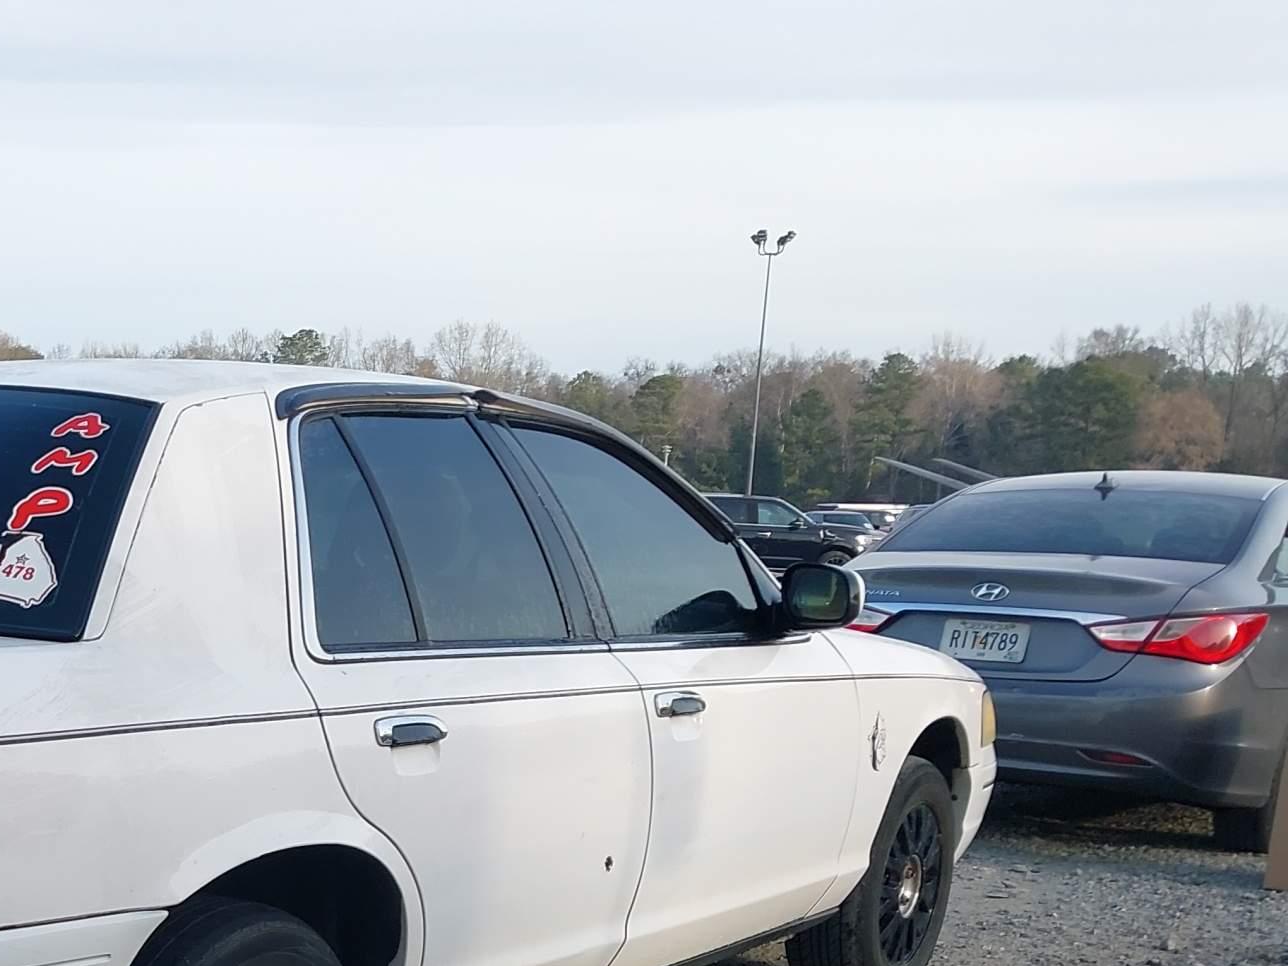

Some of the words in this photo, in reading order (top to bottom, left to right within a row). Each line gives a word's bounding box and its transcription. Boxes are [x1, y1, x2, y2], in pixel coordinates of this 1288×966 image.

[8, 412, 110, 532] AMP
[2, 564, 35, 581] 478
[949, 629, 1020, 652] RIT4789
